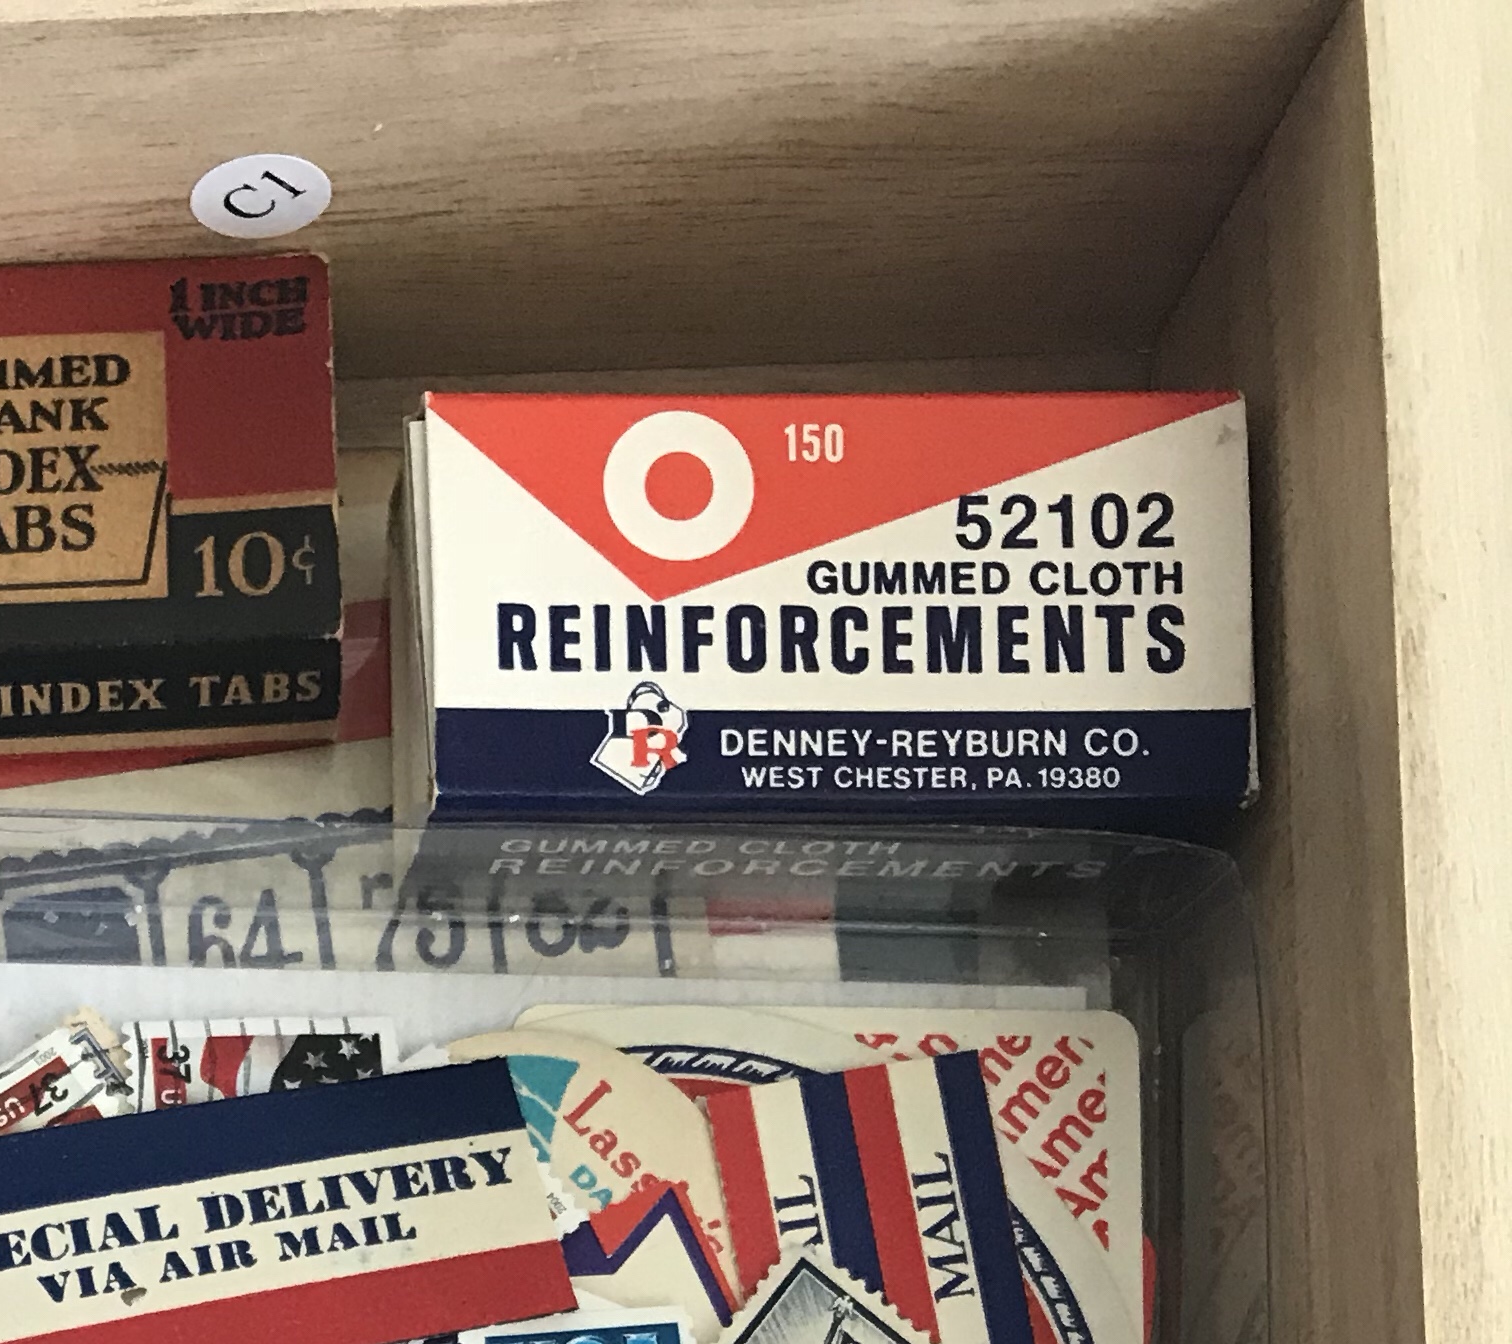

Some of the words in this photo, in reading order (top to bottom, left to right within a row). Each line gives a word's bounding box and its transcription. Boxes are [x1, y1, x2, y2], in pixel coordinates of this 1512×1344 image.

[199, 276, 309, 310] INCH
[173, 308, 306, 341] WIDE
[785, 423, 846, 464] 150
[955, 493, 1176, 550] 52102
[193, 531, 317, 598] 10¢
[806, 559, 1010, 597] GUMMED
[1029, 559, 1185, 597] CLOTH
[497, 602, 1188, 675] REINFORCEMENTS
[190, 670, 323, 706] TABS
[720, 727, 1068, 760] DENNEY-REYBURN
[1085, 727, 1151, 758] CO.
[742, 766, 826, 789] WEST
[834, 766, 977, 794] CHESTER,
[498, 839, 717, 856] GUMMED
[738, 839, 902, 856] CLOTH
[488, 858, 1110, 880] REINFORCEMENTS
[157, 1044, 192, 1084] 37
[28, 1073, 69, 1117] 37
[195, 1146, 514, 1235] DELIVERY
[911, 1150, 976, 1304] MAIL
[36, 1264, 138, 1302] VIA
[157, 1239, 258, 1285] AIR
[276, 1211, 418, 1263] MAIL
